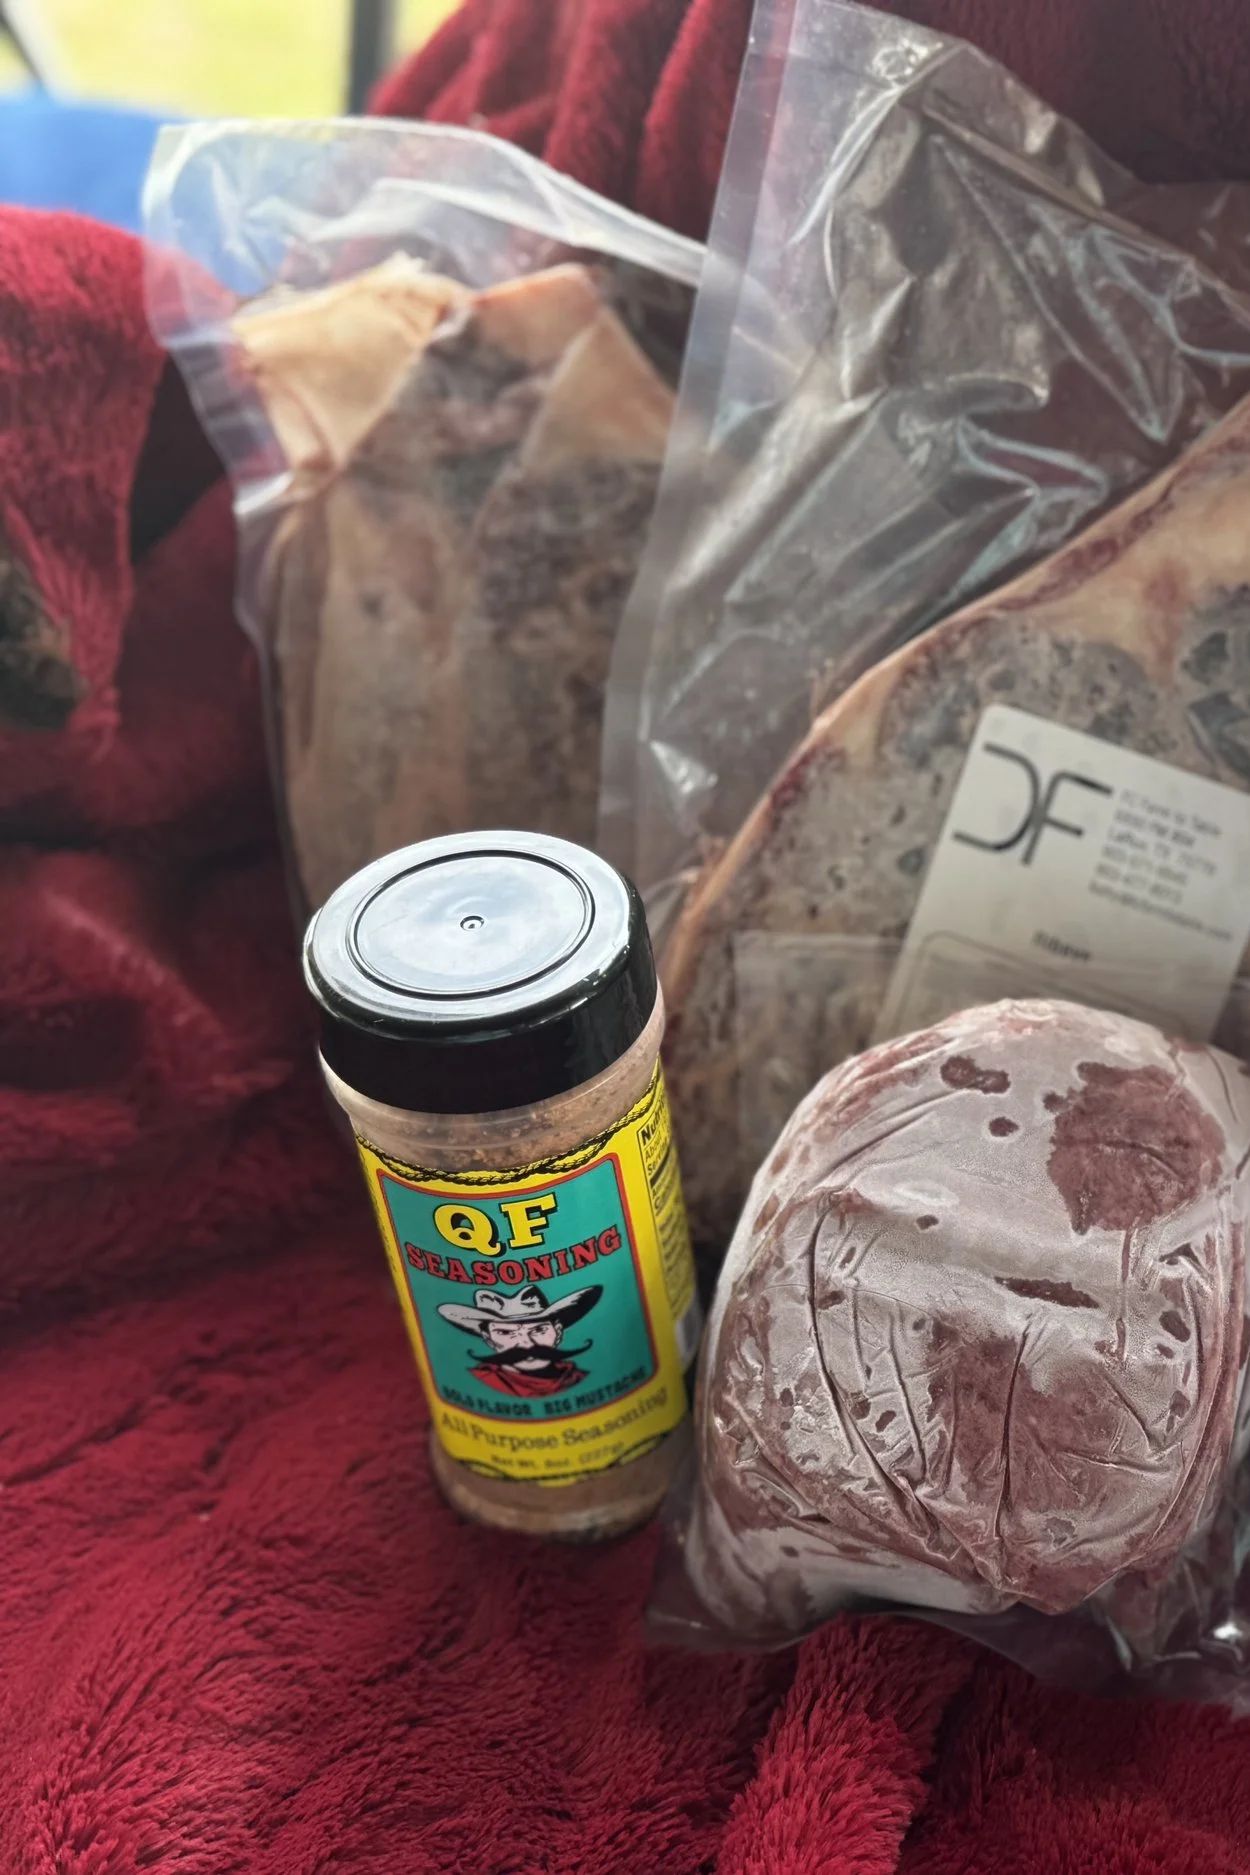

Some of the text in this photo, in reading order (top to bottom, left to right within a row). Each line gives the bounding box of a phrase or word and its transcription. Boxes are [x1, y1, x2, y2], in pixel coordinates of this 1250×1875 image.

[405, 1225, 622, 1287] SEASONING
[433, 1191, 559, 1257] QF
[442, 1386, 668, 1452] All Purpose Seasoning
